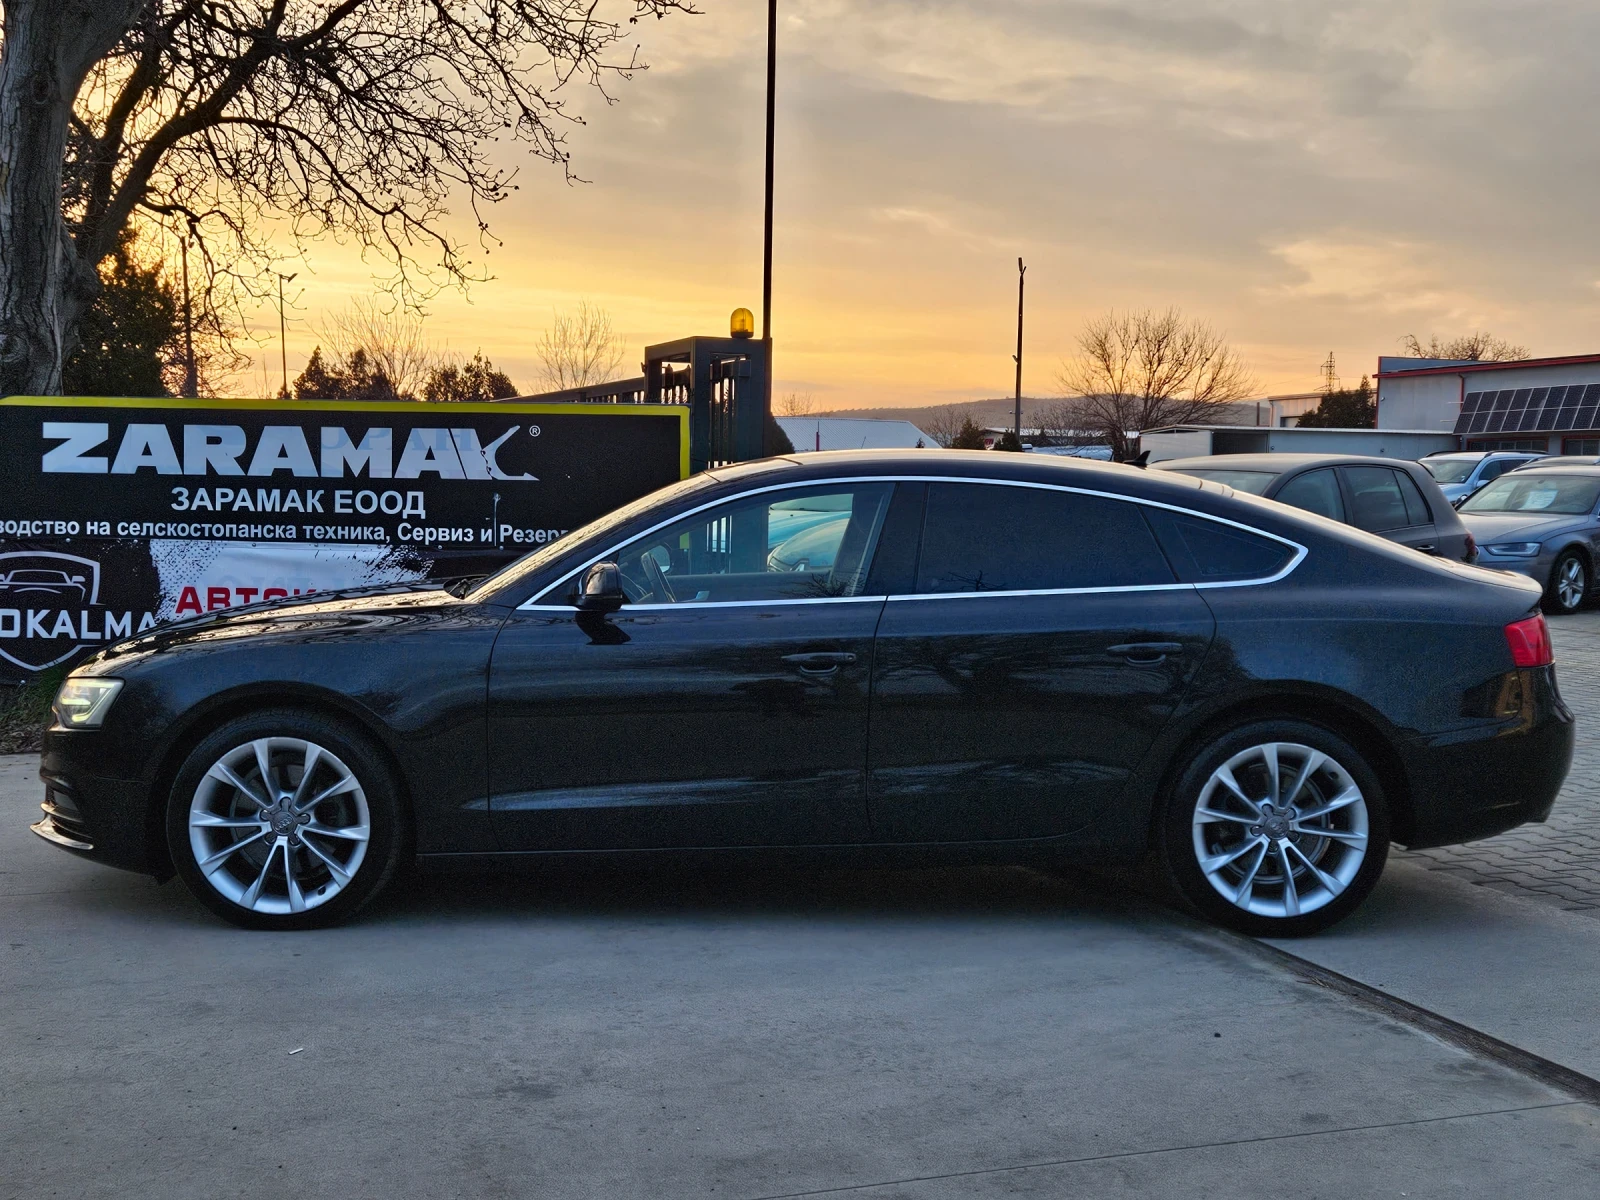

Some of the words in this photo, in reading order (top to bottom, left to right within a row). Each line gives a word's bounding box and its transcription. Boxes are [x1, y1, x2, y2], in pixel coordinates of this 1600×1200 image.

[42, 421, 540, 481] ZARAMAK
[171, 486, 325, 513] ЗАРАМАК
[334, 489, 426, 519] ЕООД
[86, 521, 111, 535] на
[117, 521, 297, 540] селскостопанска
[303, 524, 391, 543] техника,
[397, 522, 475, 545] Сервиз
[480, 528, 493, 542] и
